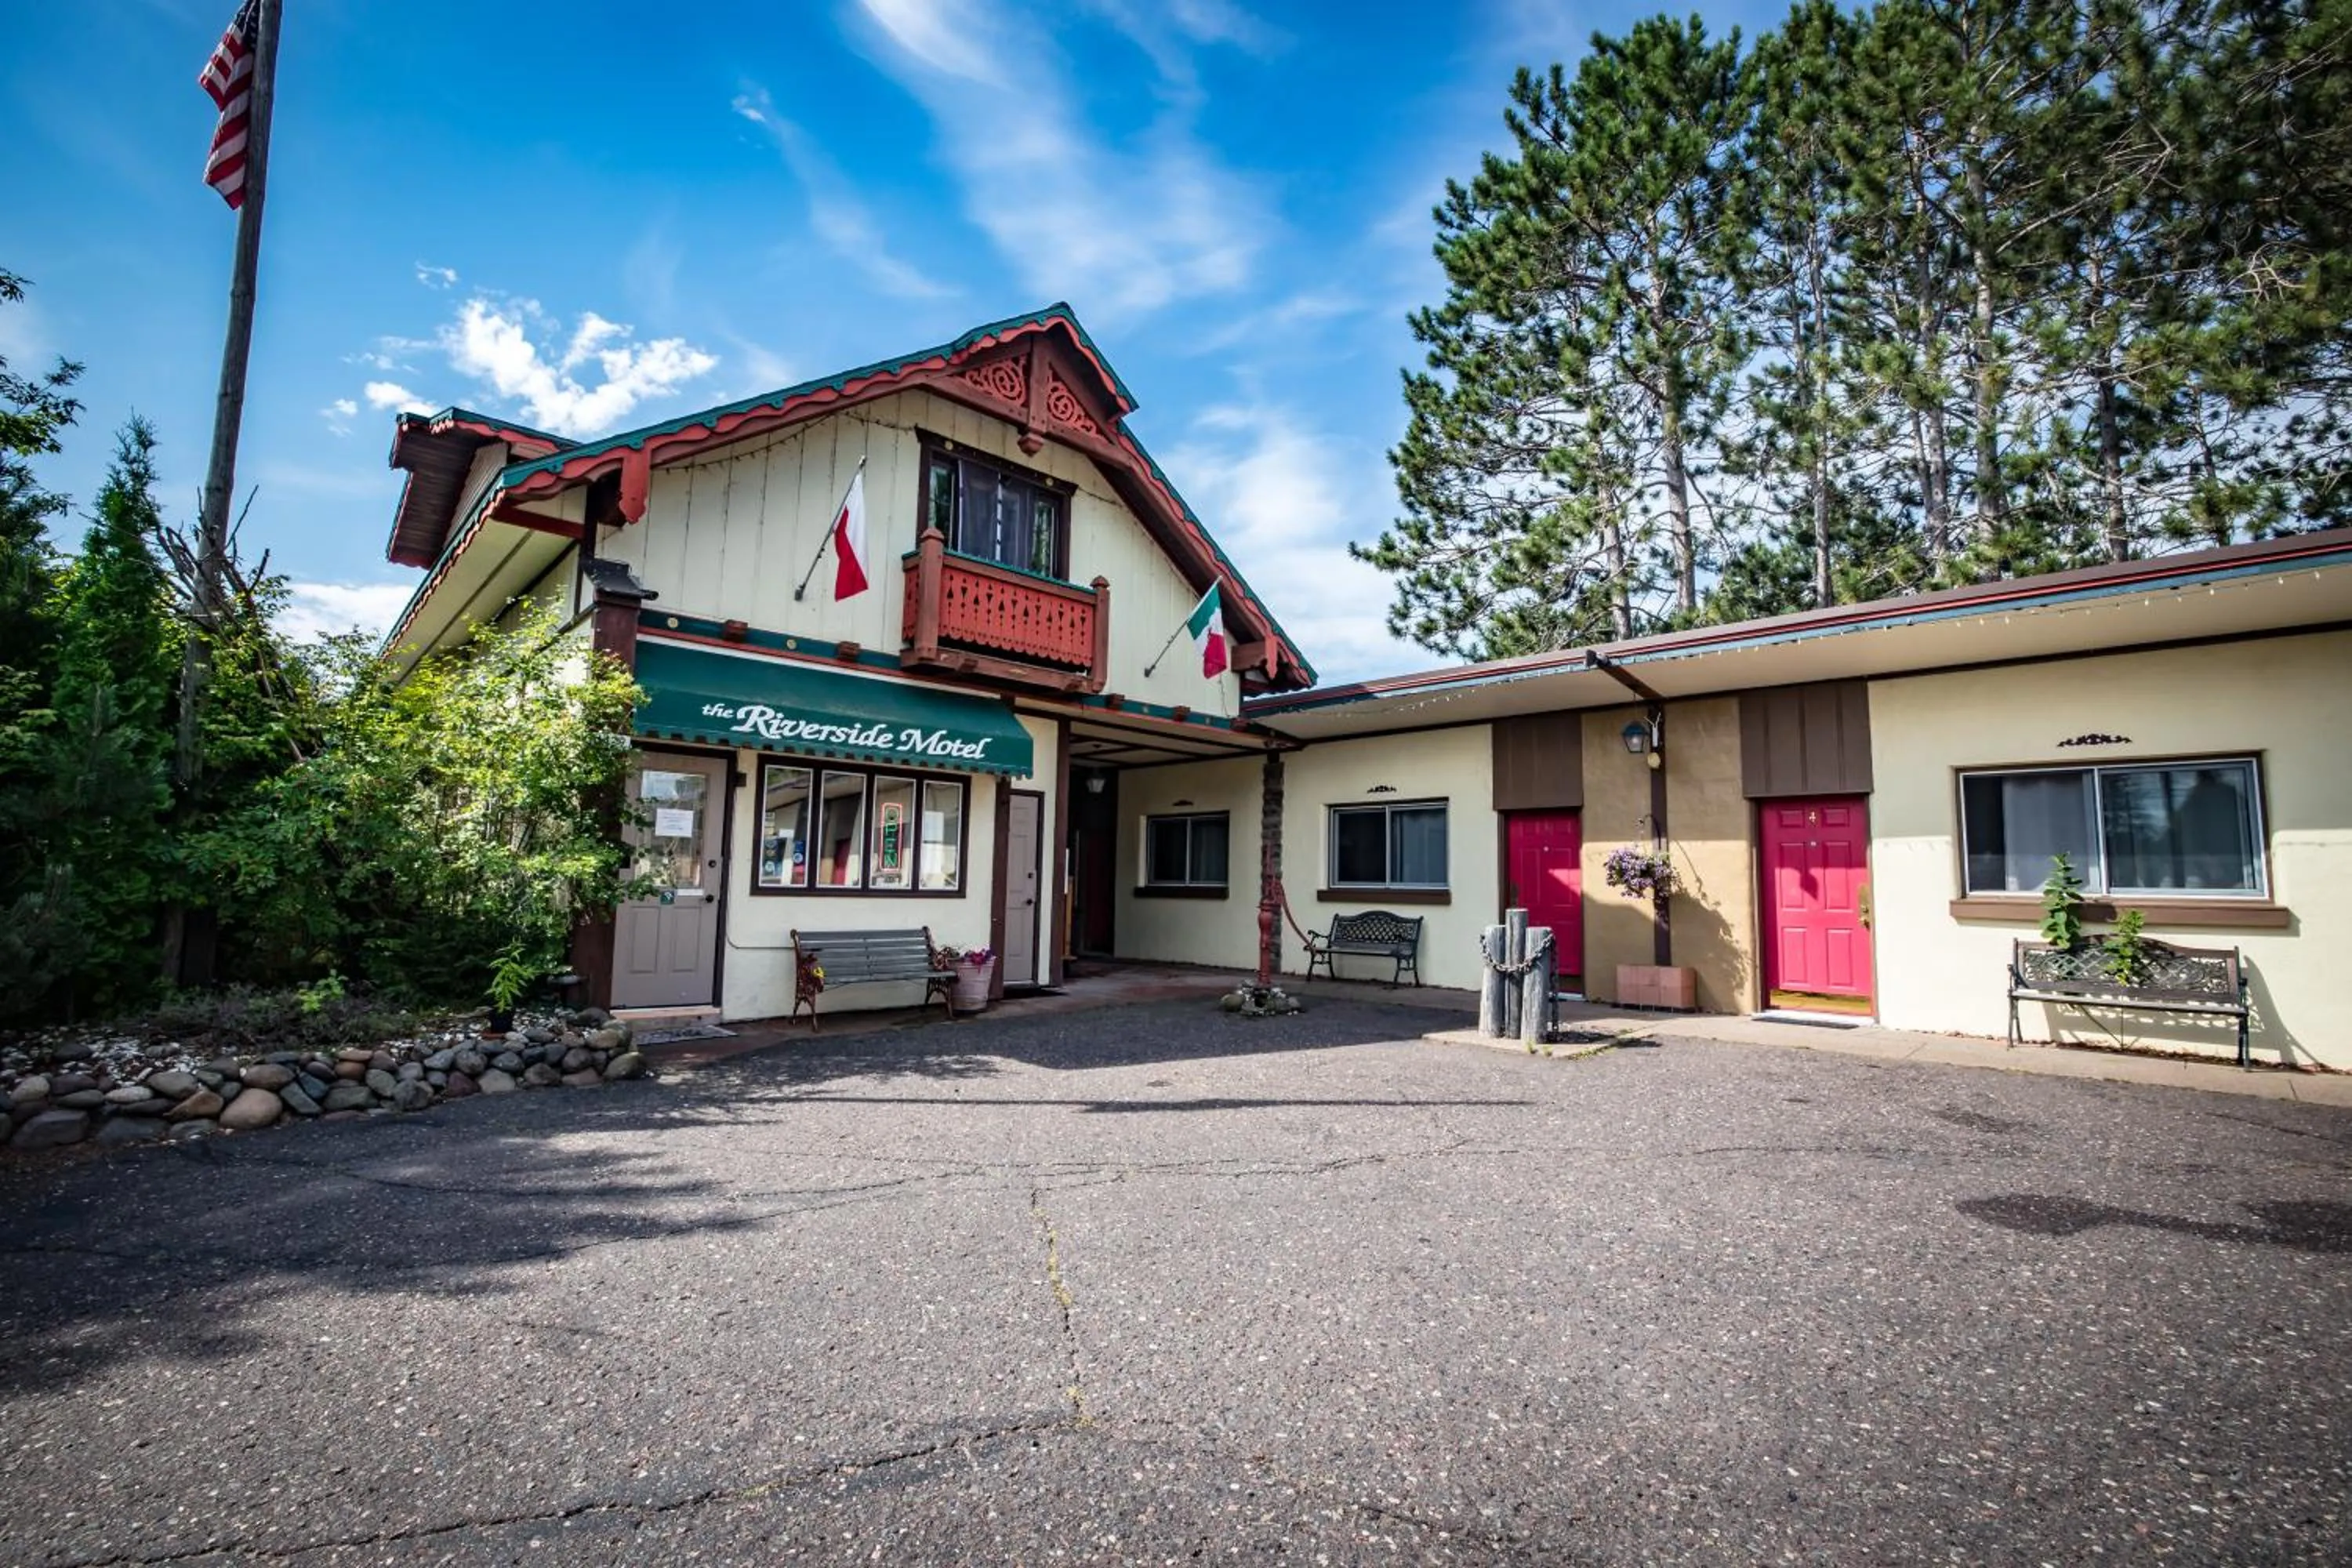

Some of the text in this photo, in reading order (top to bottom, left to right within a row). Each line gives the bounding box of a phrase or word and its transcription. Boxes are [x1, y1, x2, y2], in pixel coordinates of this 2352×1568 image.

[702, 703, 992, 759] the Riverside Motel
[884, 807, 898, 866] OPEN
